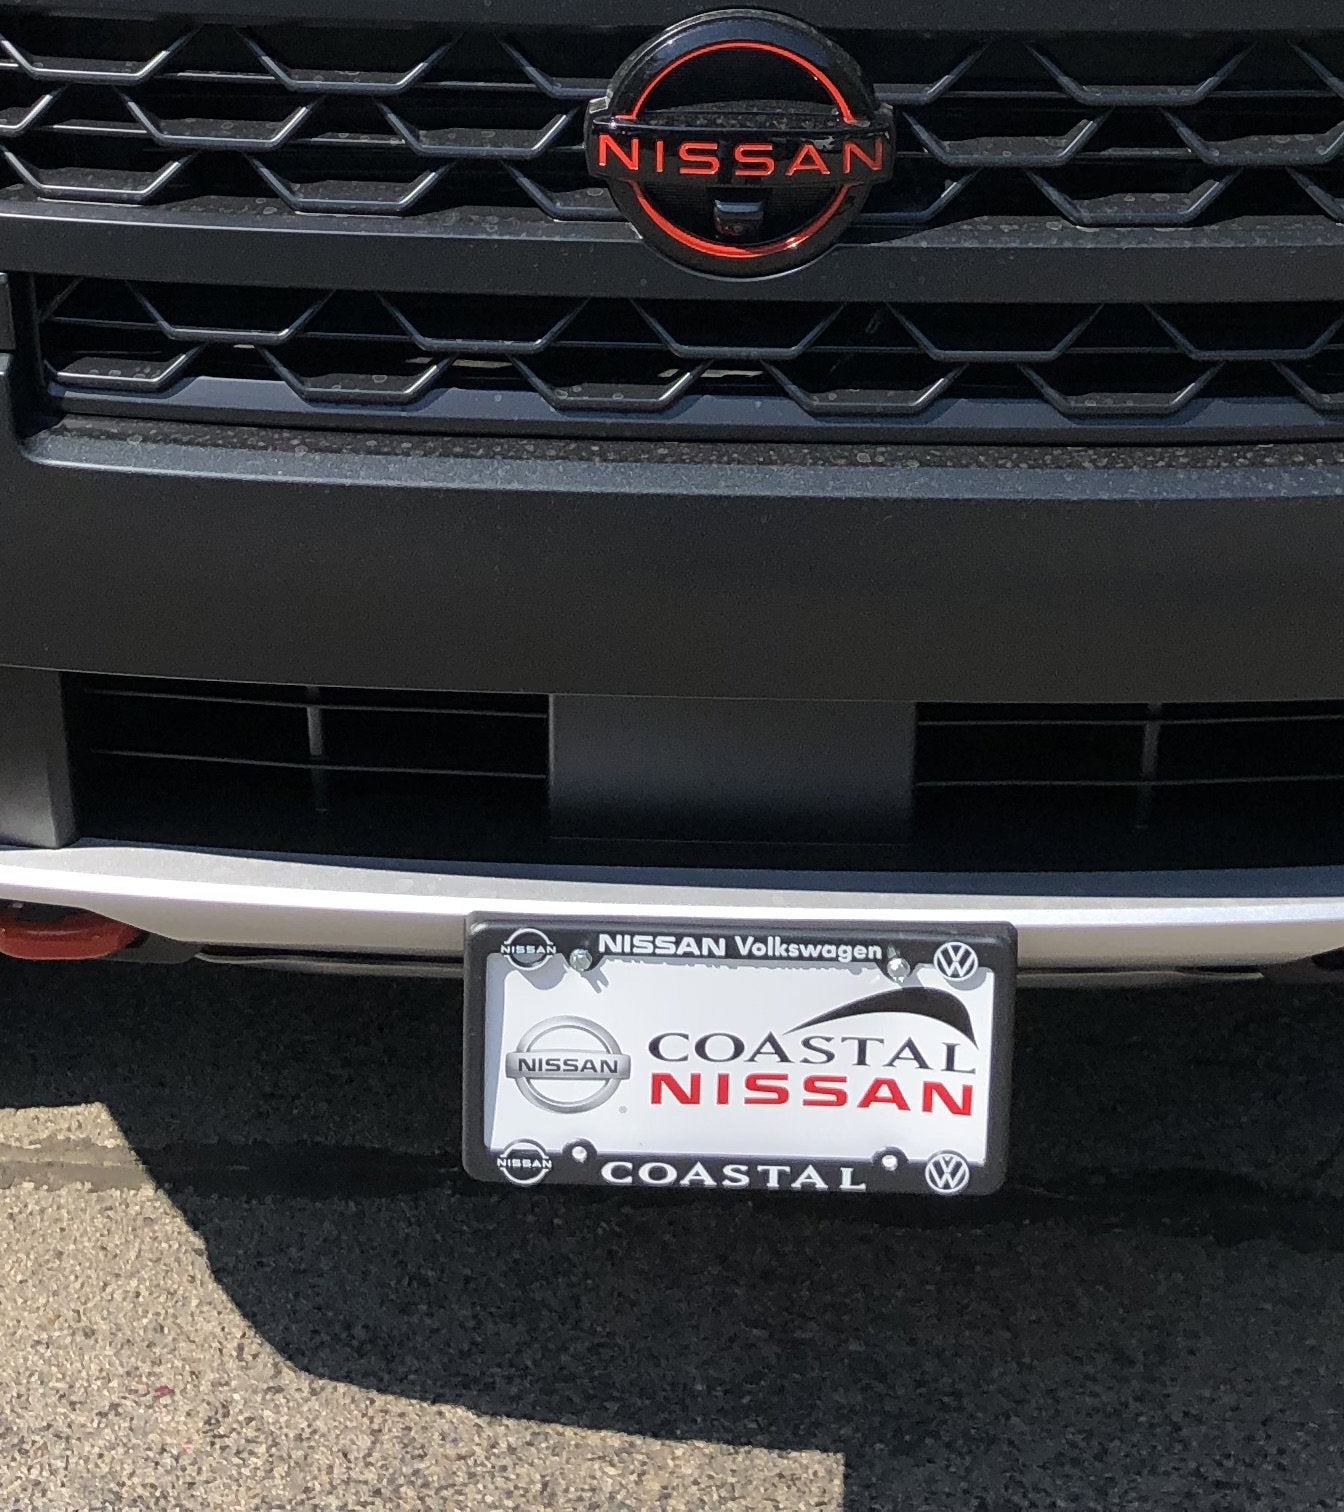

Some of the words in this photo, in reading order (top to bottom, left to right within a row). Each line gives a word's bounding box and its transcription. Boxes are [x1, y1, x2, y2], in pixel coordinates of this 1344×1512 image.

[597, 134, 883, 176] NISSAN
[500, 943, 556, 955] NISSAN
[598, 933, 726, 957] NISSAN
[733, 935, 883, 963] Volkswagen
[934, 942, 978, 981] VW
[517, 1056, 619, 1076] NISSAN
[647, 1030, 977, 1075] COASTAL
[650, 1071, 973, 1117] NISSAN
[496, 1156, 553, 1170] NISSAN
[600, 1161, 867, 1193] COASTAL
[926, 1153, 969, 1193] VW
